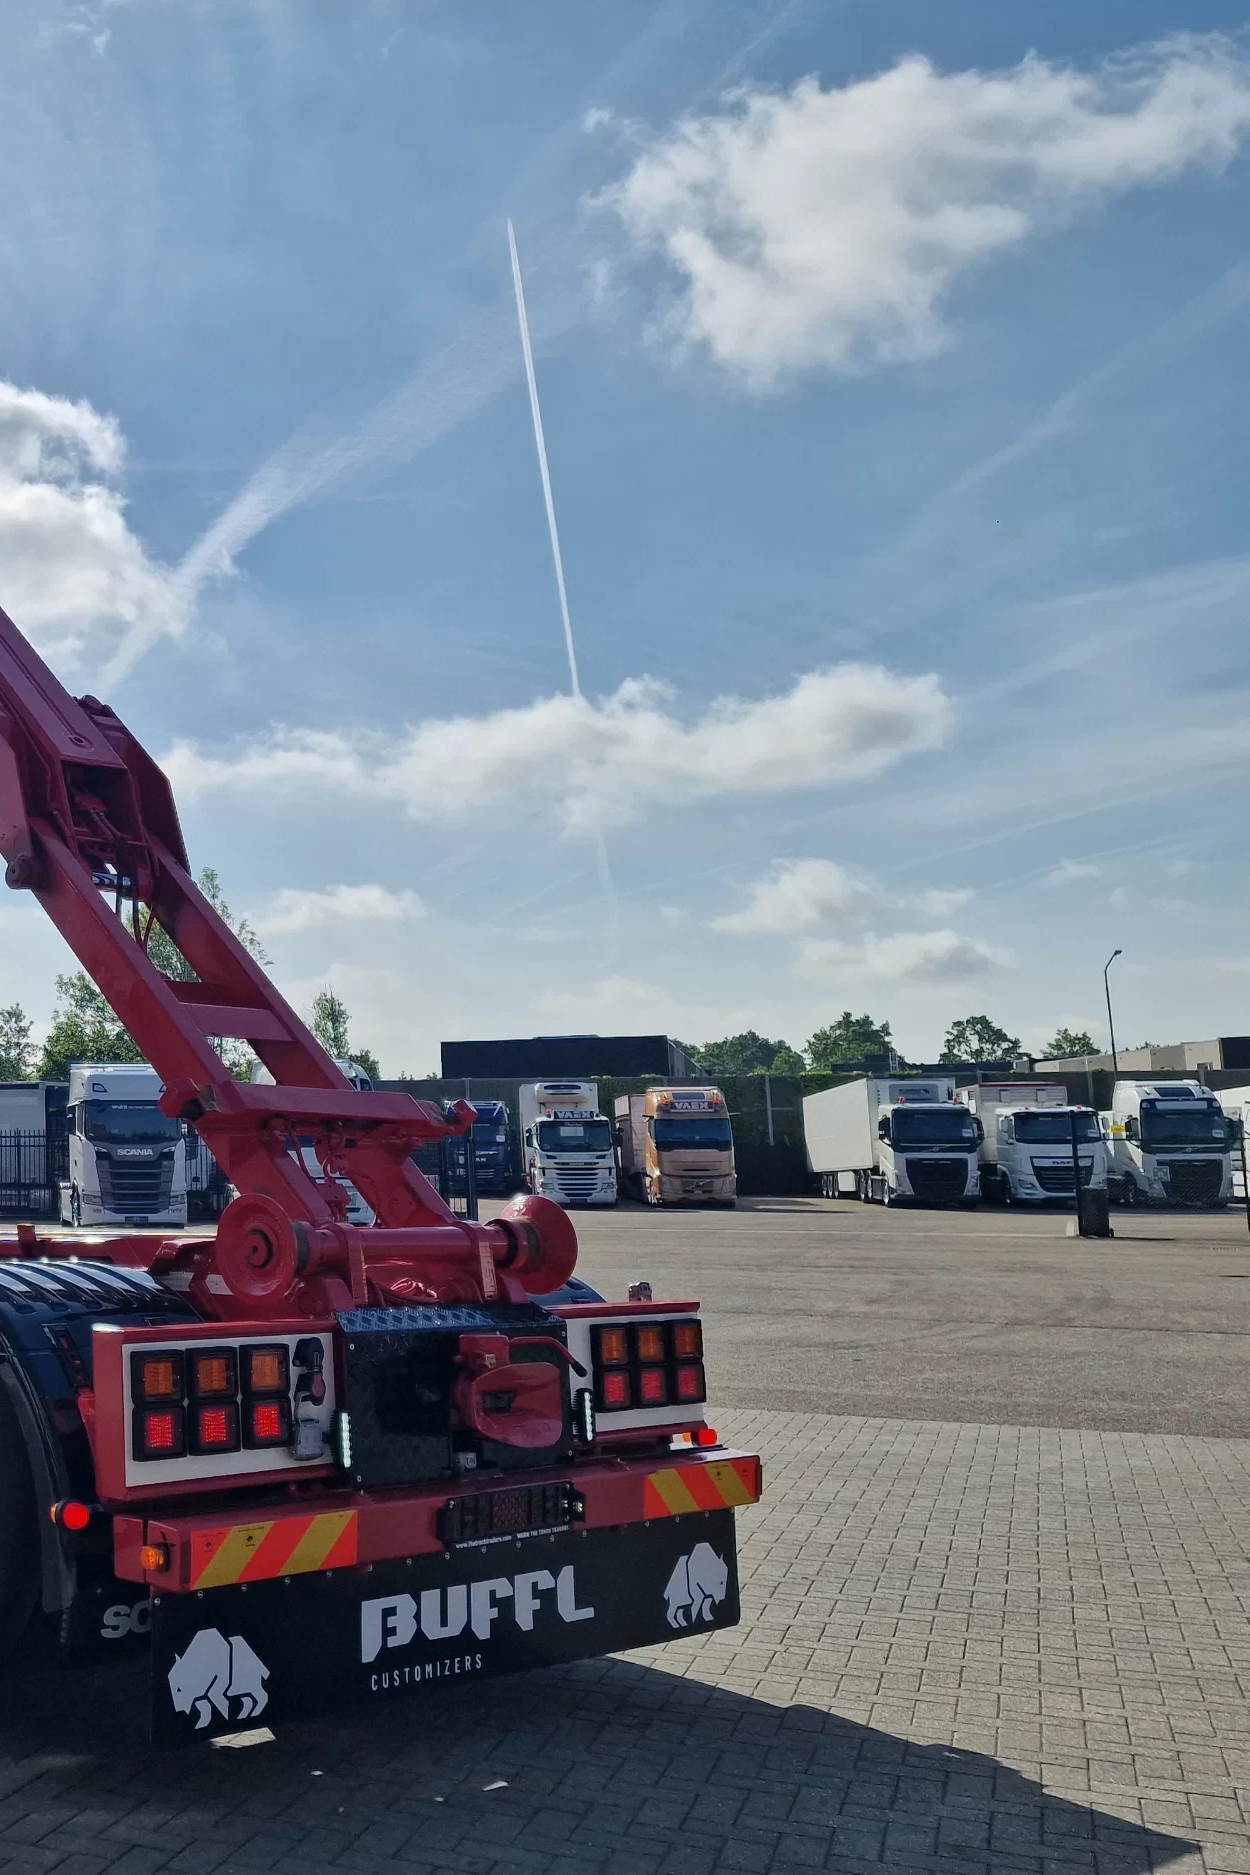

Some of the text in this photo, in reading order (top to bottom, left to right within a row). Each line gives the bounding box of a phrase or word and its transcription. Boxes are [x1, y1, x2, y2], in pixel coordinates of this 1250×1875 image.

[674, 1102, 709, 1110] VAEX
[556, 1110, 592, 1119] VAEX
[117, 1148, 154, 1156] SCANIA
[361, 1565, 595, 1664] BUFFL
[371, 1653, 483, 1692] CUSTOMIZERS
